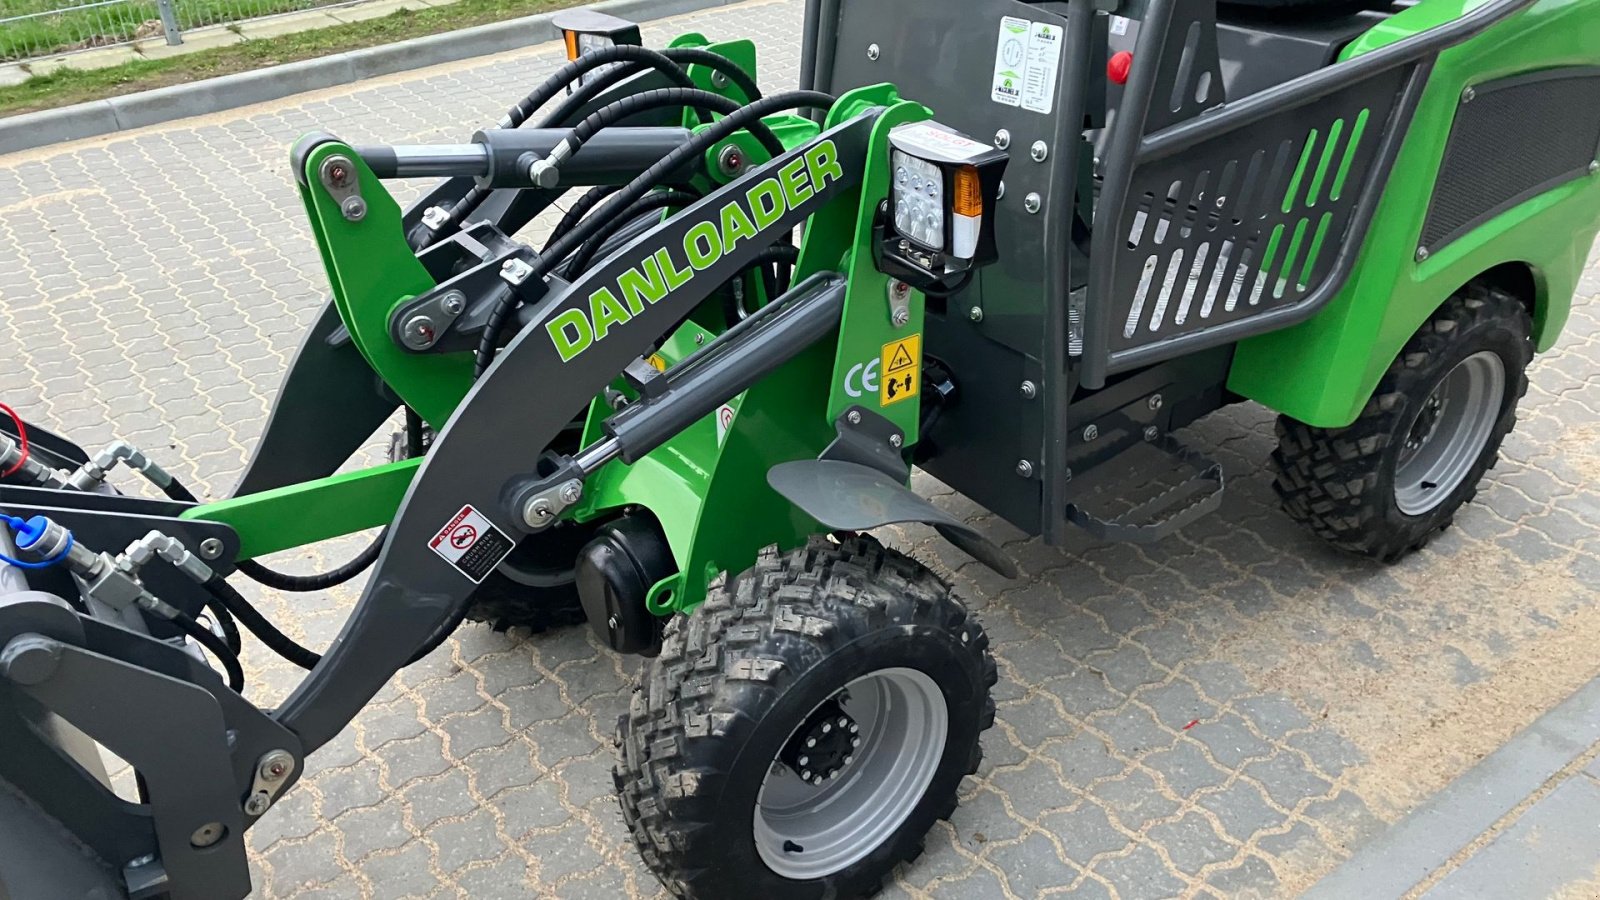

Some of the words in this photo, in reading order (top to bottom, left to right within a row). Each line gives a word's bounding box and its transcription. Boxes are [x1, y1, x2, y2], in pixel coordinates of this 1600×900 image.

[545, 139, 843, 363] DANLOADER
[844, 357, 880, 397] CE
[444, 513, 465, 535] DANGER
[461, 545, 481, 564] CRUSH
